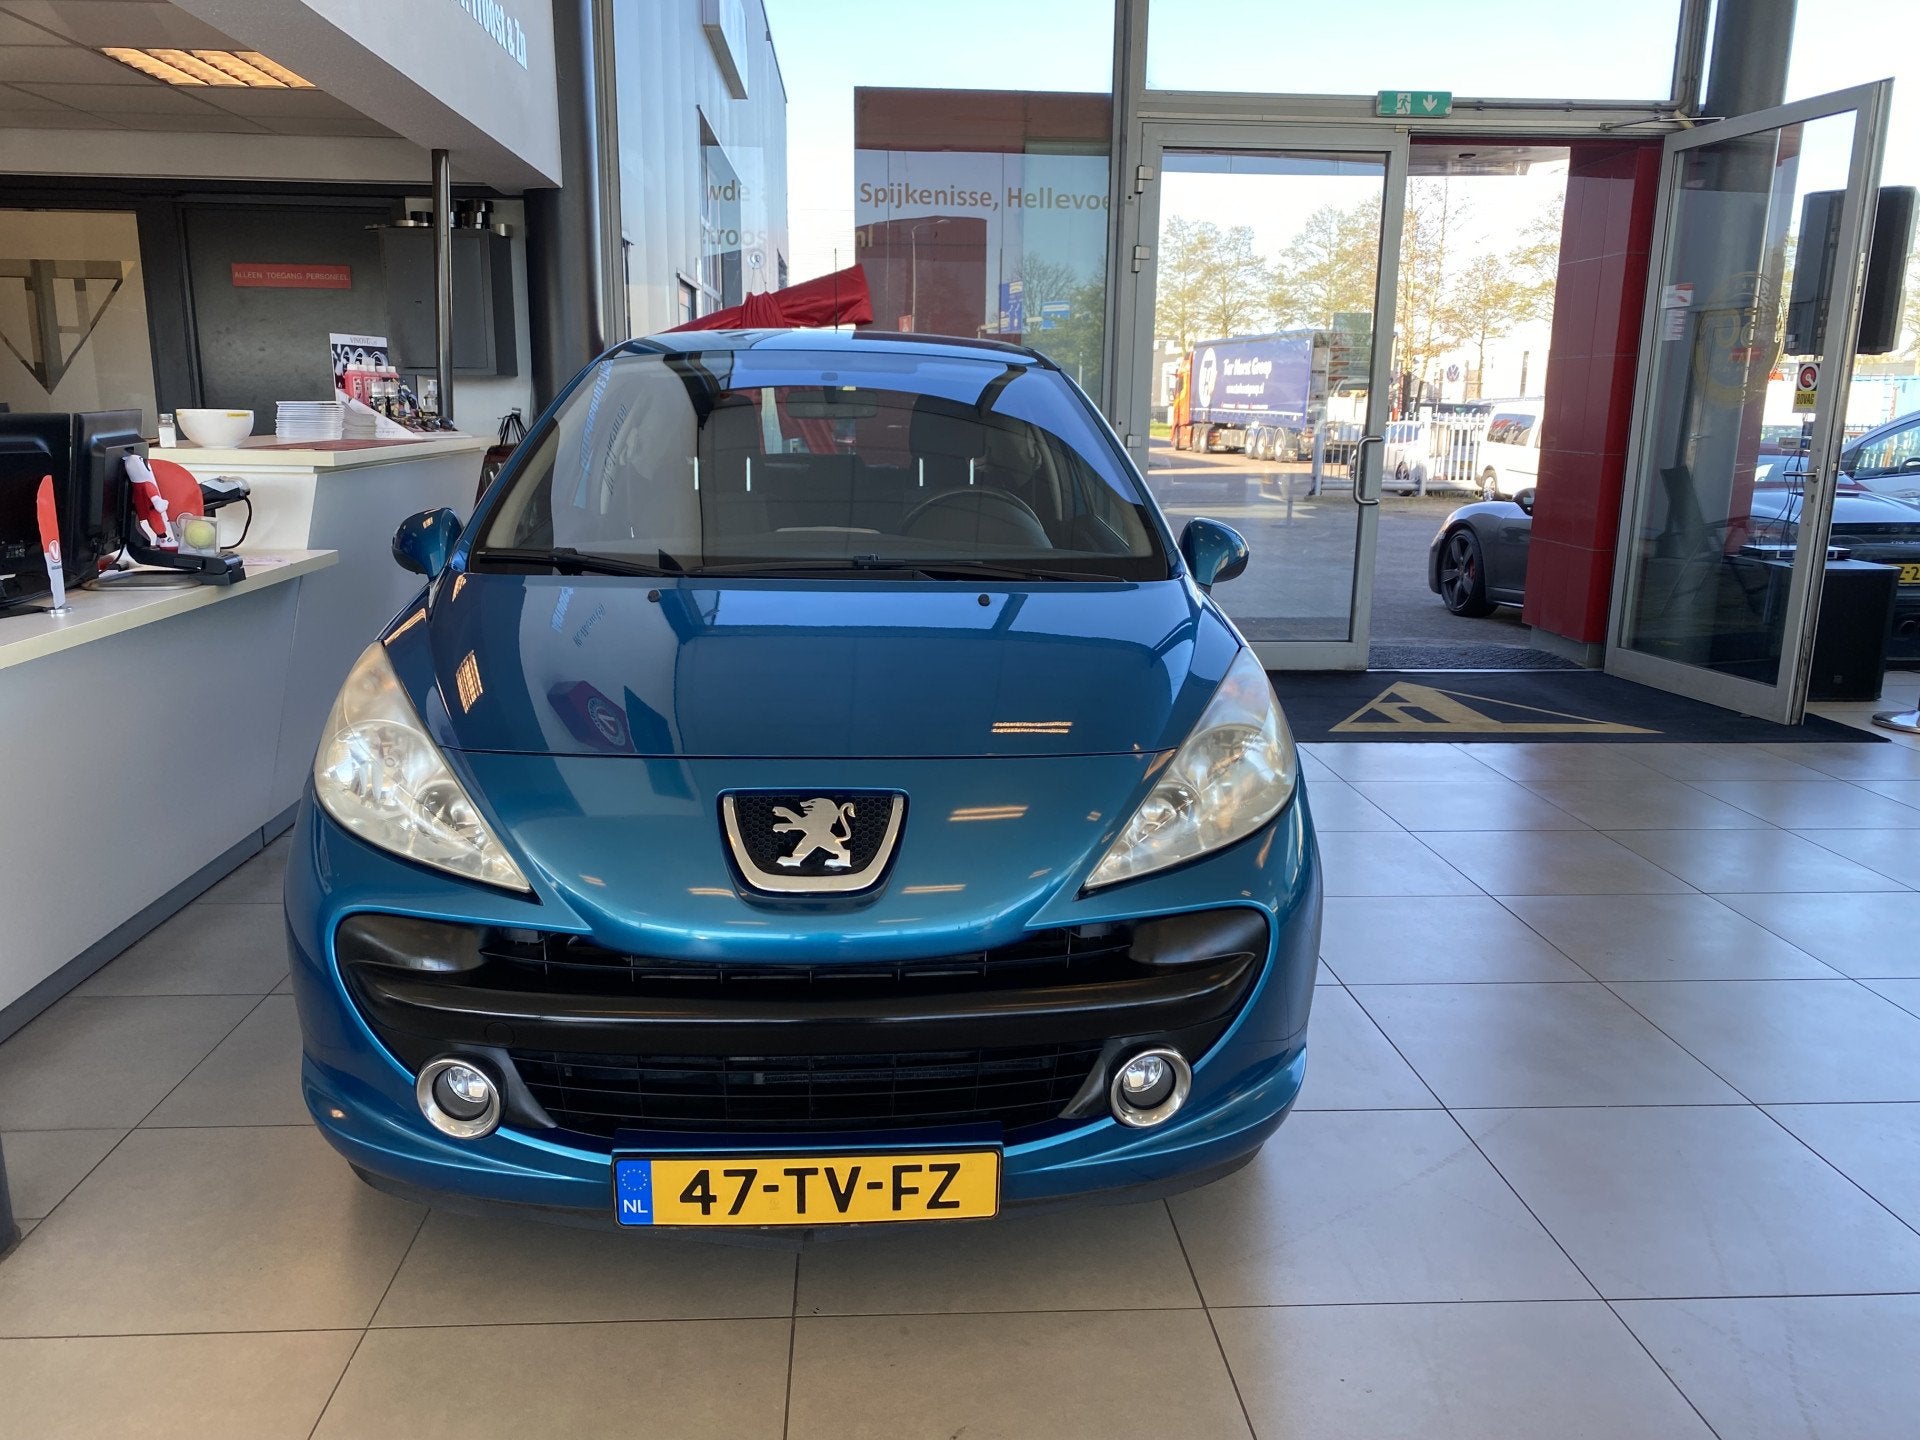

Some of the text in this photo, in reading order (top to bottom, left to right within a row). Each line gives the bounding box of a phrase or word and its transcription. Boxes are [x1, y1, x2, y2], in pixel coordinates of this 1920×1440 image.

[514, 17, 528, 71] Zn
[860, 182, 998, 212] Spijkenisse,
[234, 271, 349, 281] ALLEEN TOEGANG PERSONEEL
[679, 1163, 961, 1216] 47-TV-FZ
[623, 1199, 649, 1214] NL
